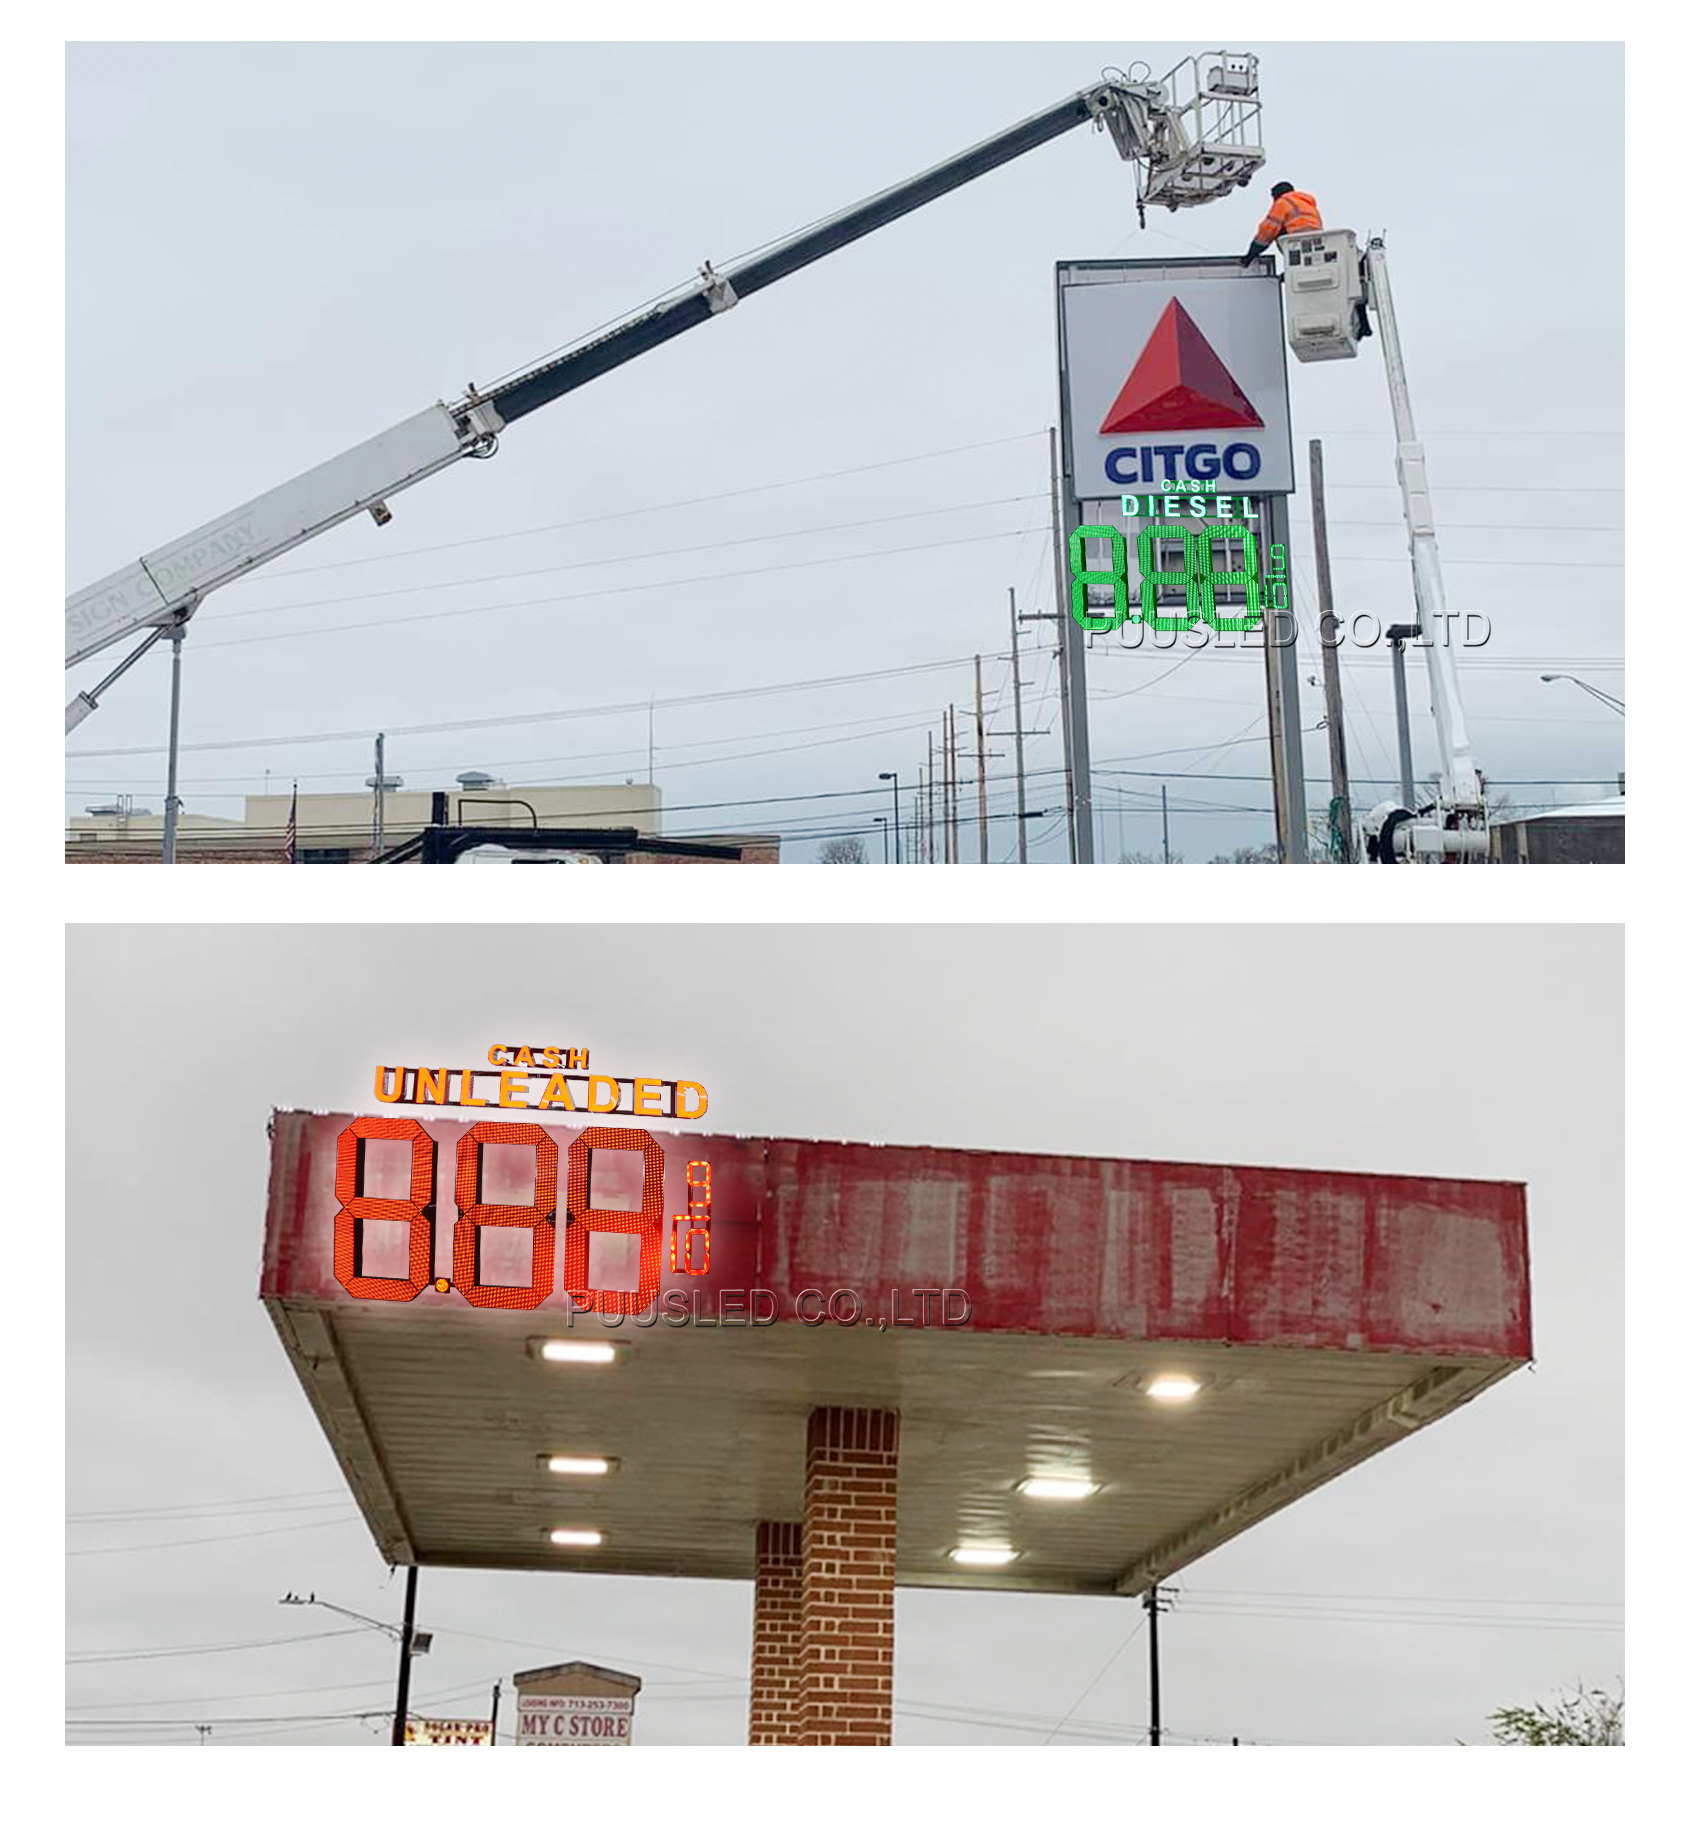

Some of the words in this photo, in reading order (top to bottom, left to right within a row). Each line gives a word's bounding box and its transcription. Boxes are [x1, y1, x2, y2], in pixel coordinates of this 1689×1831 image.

[1105, 443, 1261, 484] CITGO
[1161, 479, 1217, 493] CASH
[1121, 495, 1259, 518] DIESEL
[136, 521, 255, 599] COMPANY
[488, 1044, 590, 1070] CASH
[374, 1065, 708, 1119] UNLEADED
[521, 1714, 550, 1736] MY
[553, 1715, 565, 1736] C
[568, 1715, 629, 1738] STORE
